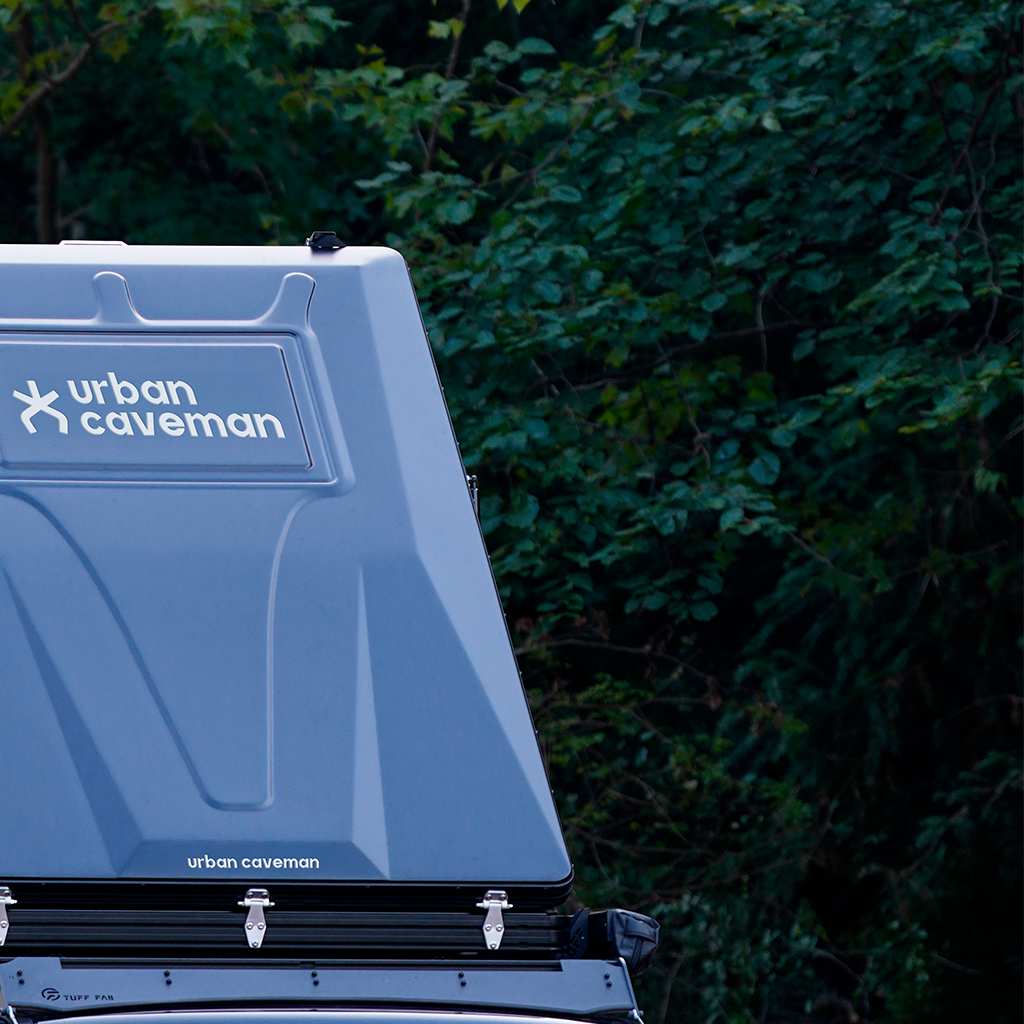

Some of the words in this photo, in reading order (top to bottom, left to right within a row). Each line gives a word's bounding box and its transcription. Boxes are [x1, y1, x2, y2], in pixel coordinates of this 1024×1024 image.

[67, 371, 198, 405] urban
[80, 411, 286, 439] caveman
[187, 854, 238, 869] urban
[241, 857, 320, 869] caveman
